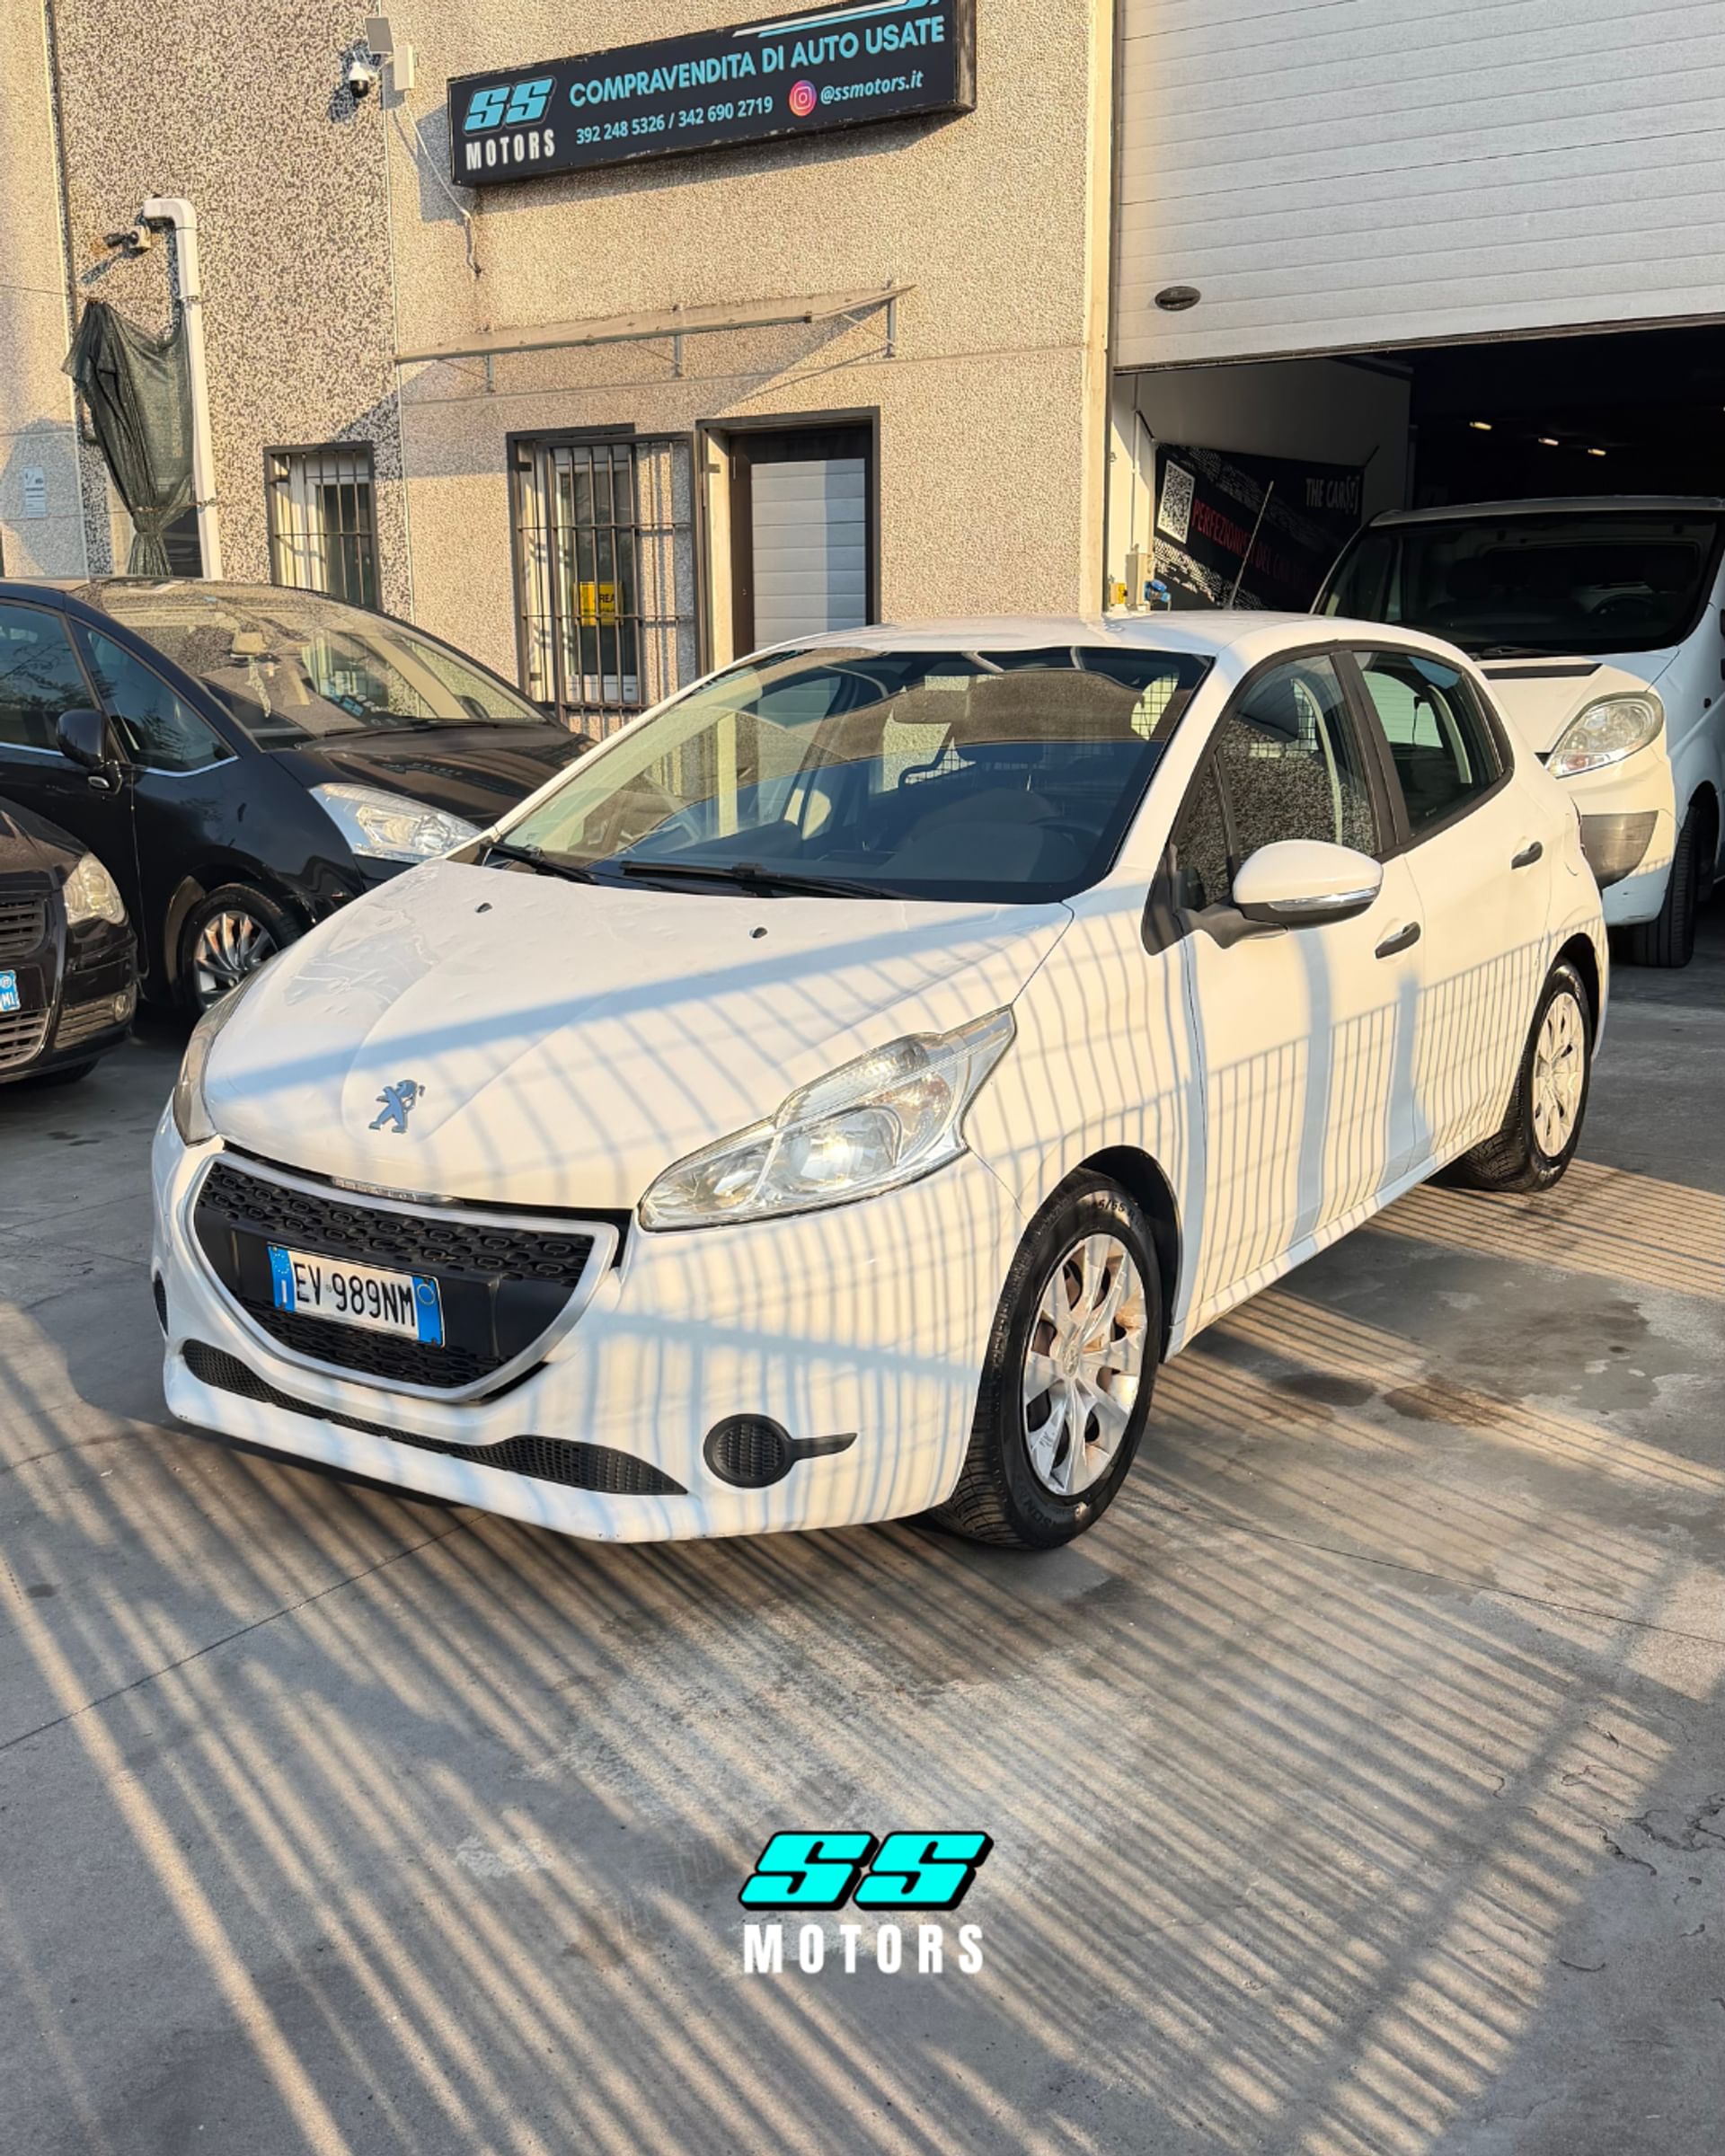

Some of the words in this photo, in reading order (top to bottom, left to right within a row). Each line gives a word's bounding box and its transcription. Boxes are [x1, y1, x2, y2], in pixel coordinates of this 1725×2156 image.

[569, 51, 757, 108] COMPRAVENDITA
[761, 44, 785, 74] DI
[790, 31, 860, 69] AUTO
[865, 15, 945, 54] USATE
[464, 77, 554, 132] SS
[819, 70, 924, 105] @ssmotors.it
[576, 126, 600, 145] 392
[603, 120, 629, 140] 248
[632, 115, 666, 136] 5326
[678, 107, 704, 128] 342
[707, 102, 734, 123] 690
[737, 95, 774, 118] 2719
[465, 128, 556, 171] MOTORS
[1305, 477, 1325, 508] THE
[293, 1262, 322, 1305] EV
[331, 1272, 416, 1327] 989NM
